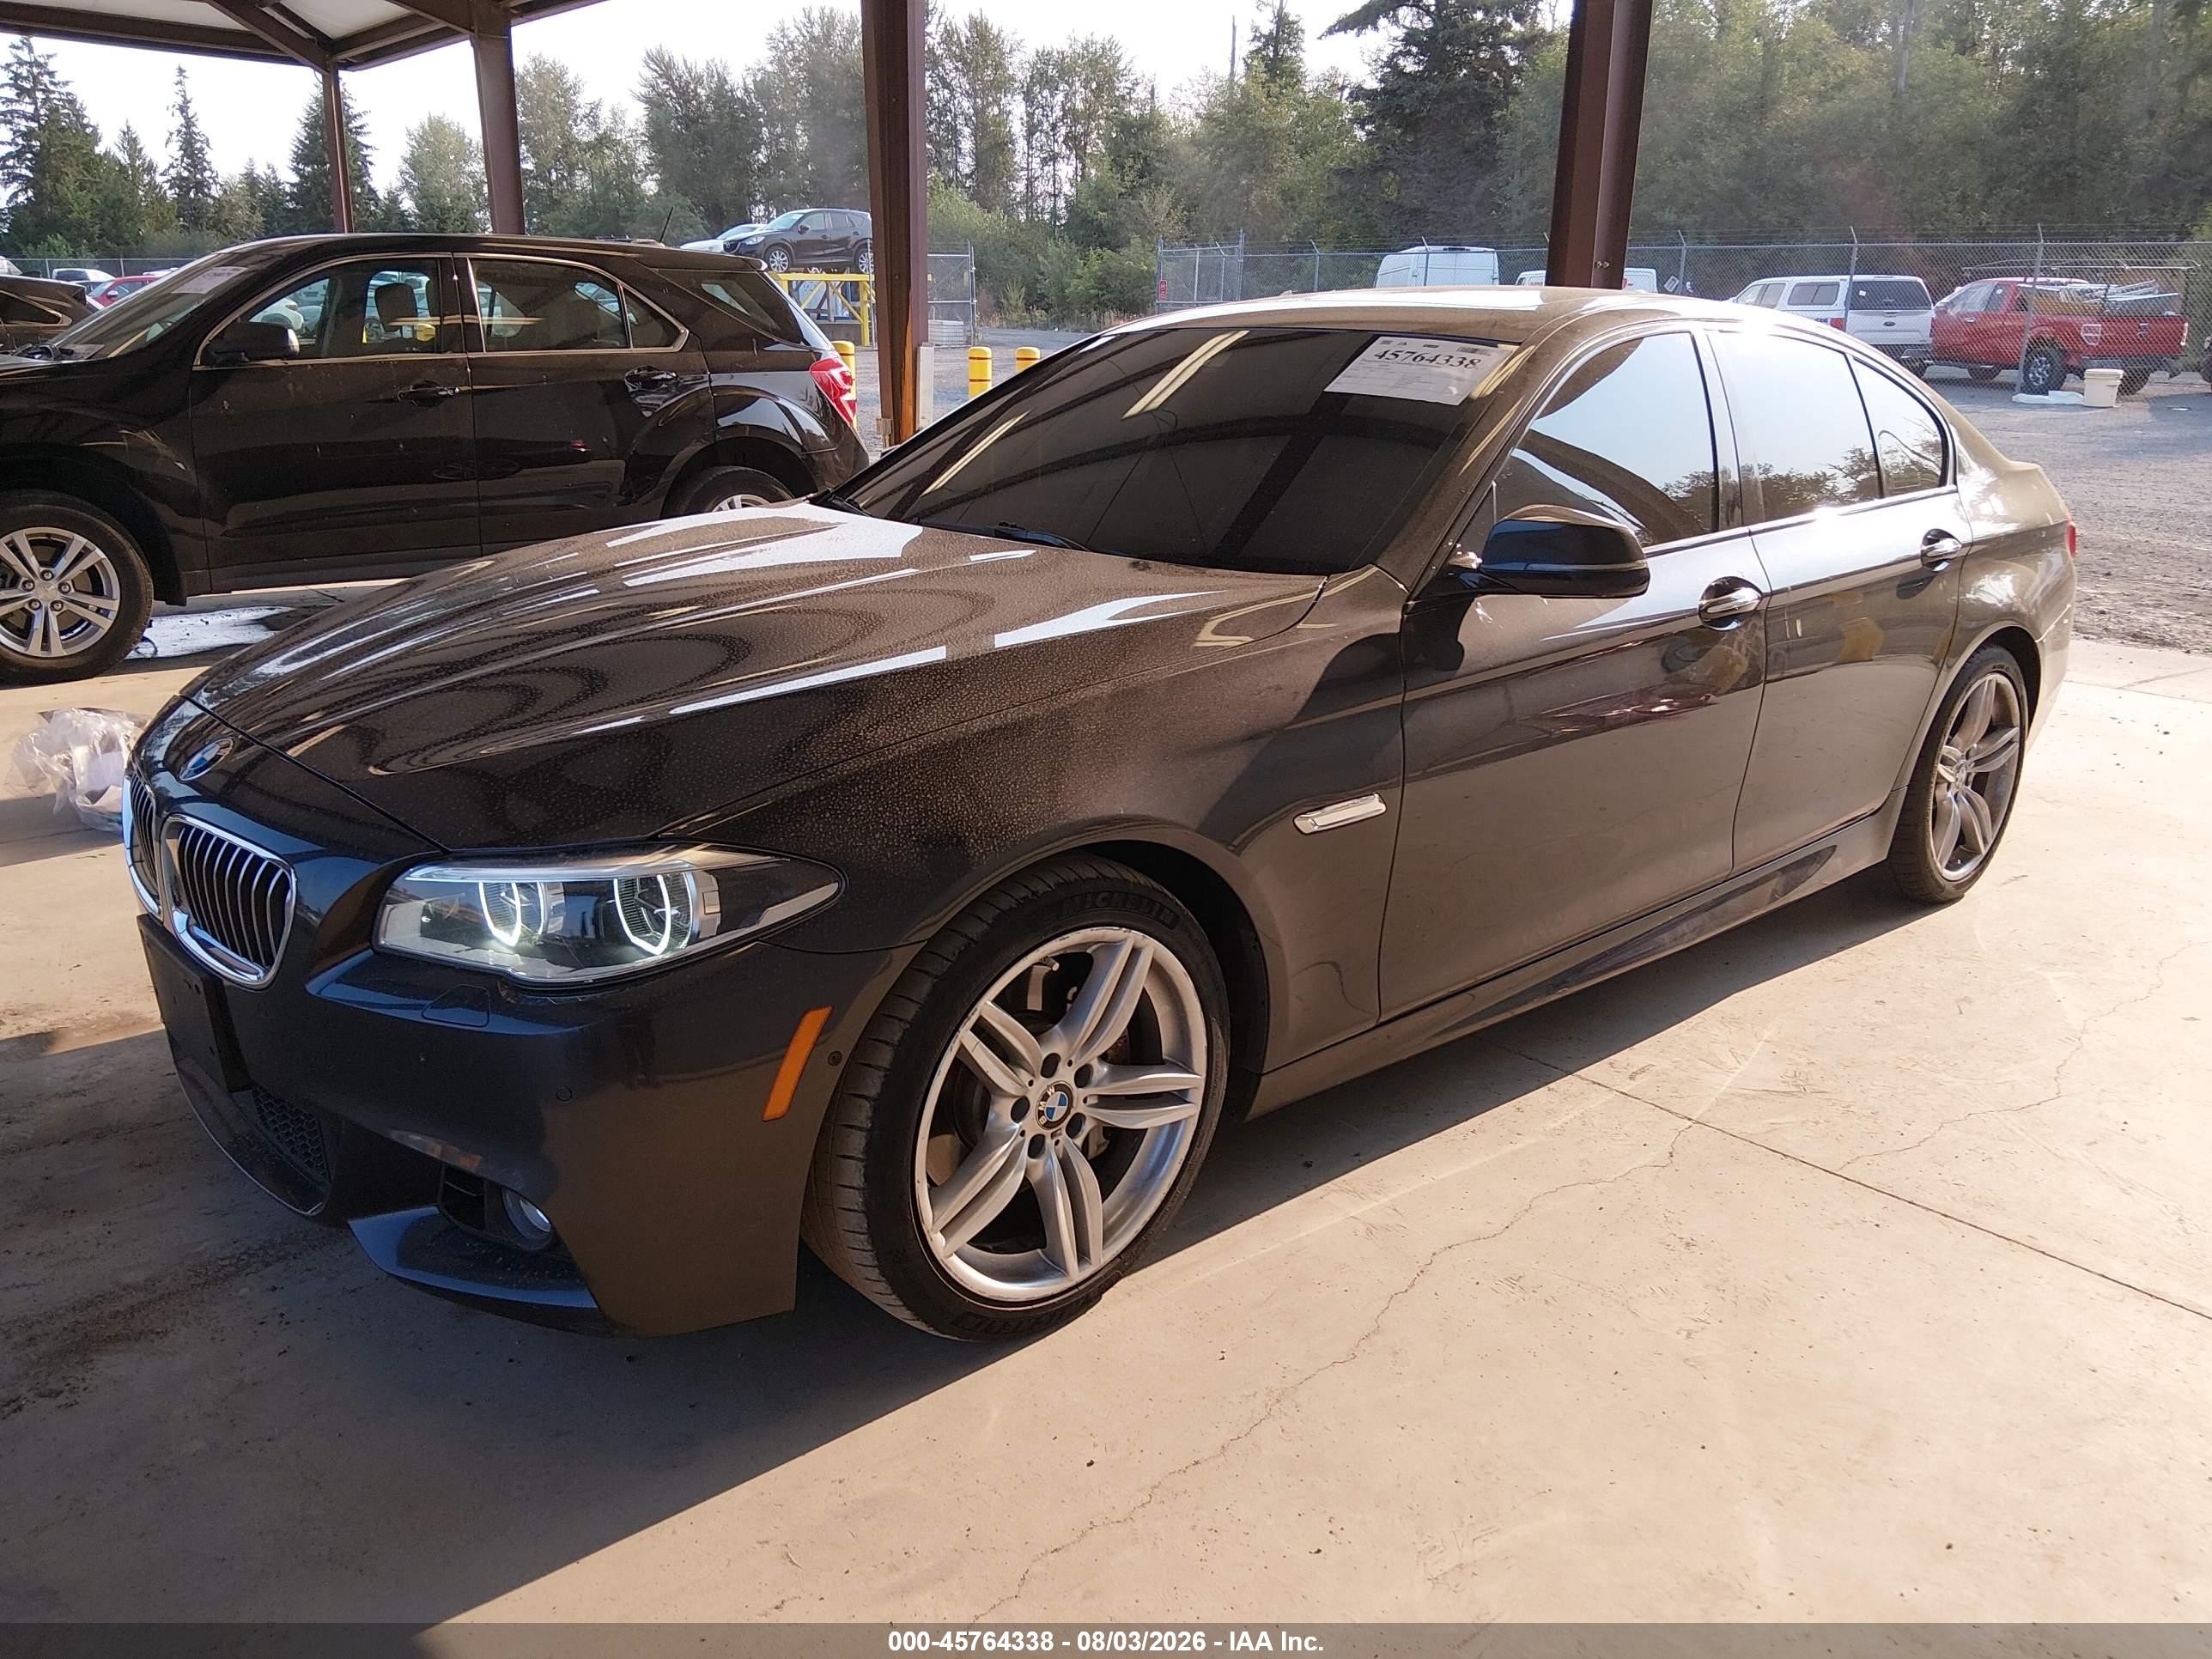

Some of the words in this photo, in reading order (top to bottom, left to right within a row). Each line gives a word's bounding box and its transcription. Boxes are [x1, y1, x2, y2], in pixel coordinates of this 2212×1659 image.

[1374, 349, 1482, 369] 45764338
[1061, 891, 1176, 923] MICHELIN
[1038, 1085, 1056, 1125] BMW
